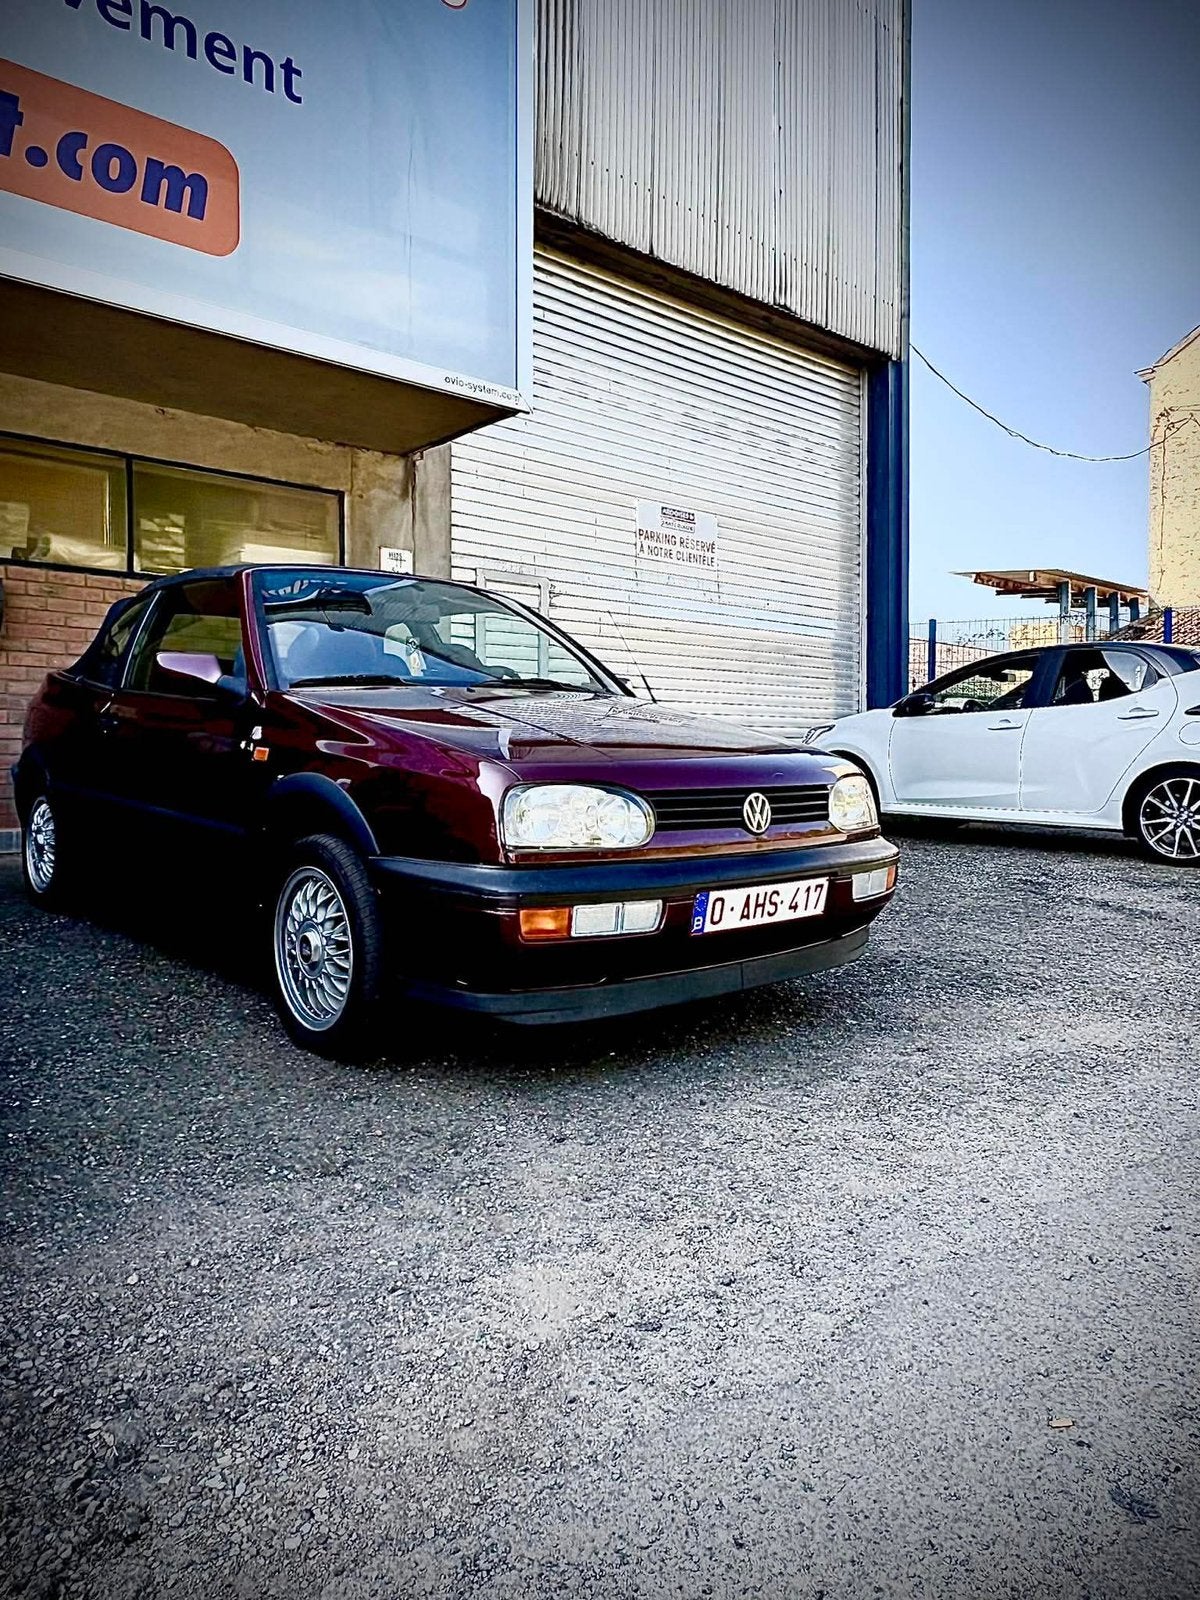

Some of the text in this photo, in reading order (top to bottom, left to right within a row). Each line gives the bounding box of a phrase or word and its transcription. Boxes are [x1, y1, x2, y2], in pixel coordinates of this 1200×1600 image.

[62, 0, 303, 105] ement
[638, 528, 716, 554] PARKING RÉSERVÉ
[639, 541, 715, 567] À NOTRE CLIENTÈLE
